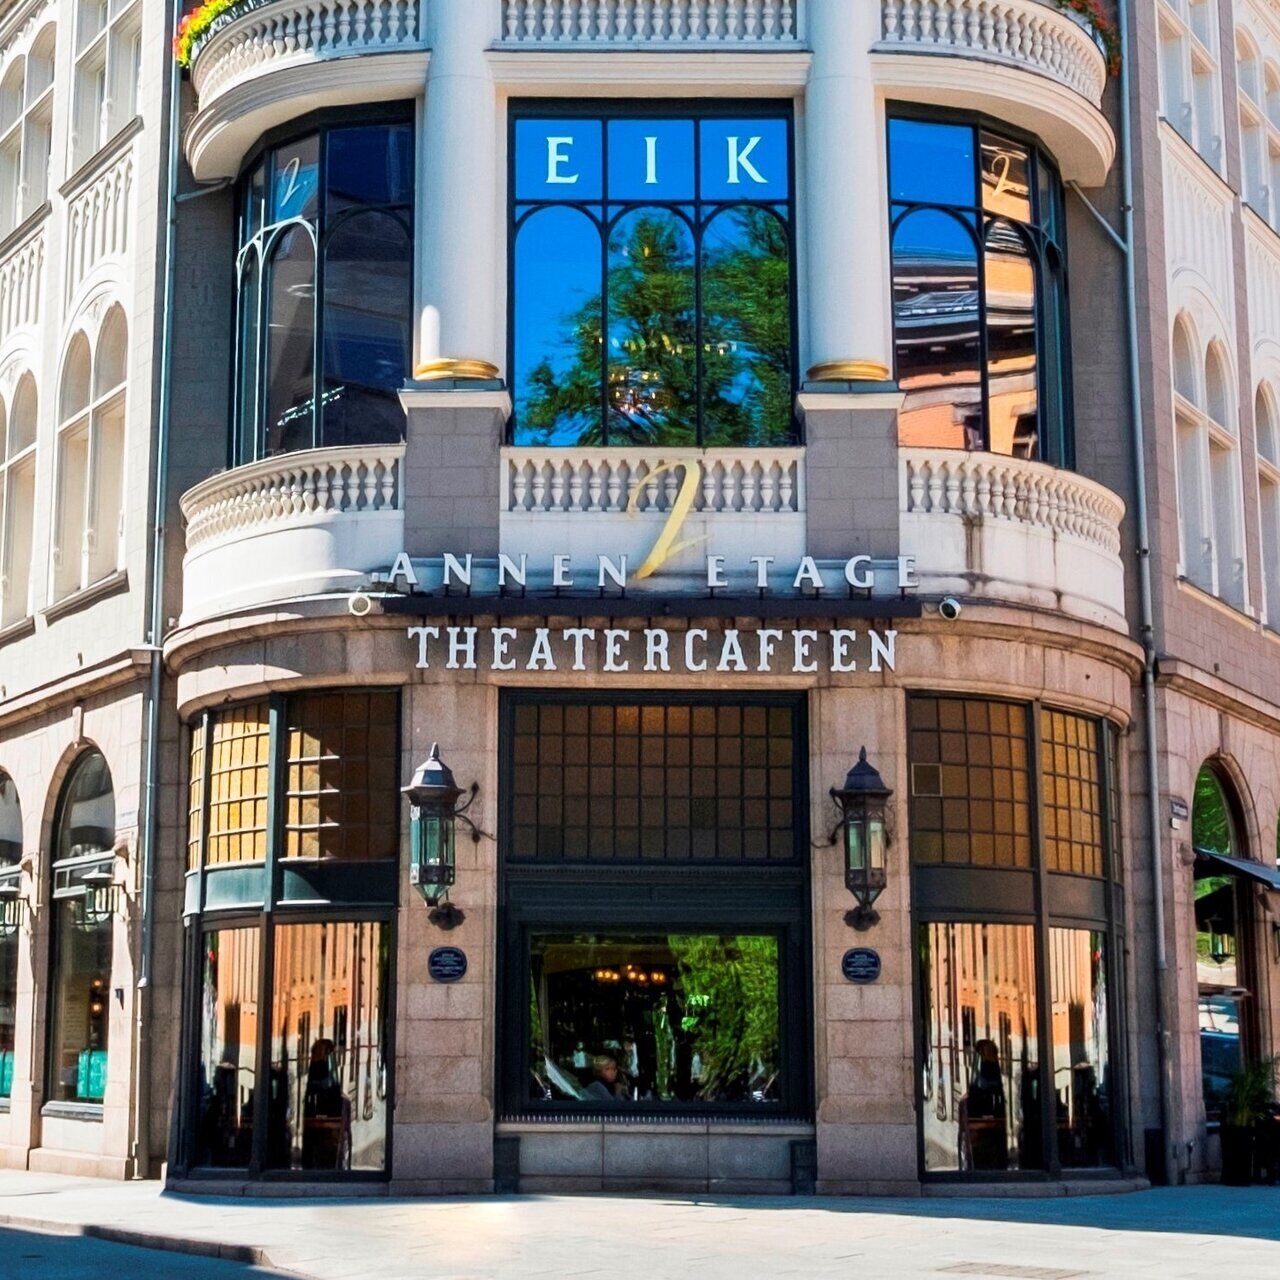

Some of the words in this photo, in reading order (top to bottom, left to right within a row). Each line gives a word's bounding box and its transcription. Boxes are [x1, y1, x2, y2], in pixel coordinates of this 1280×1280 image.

[546, 136, 768, 184] EIK
[388, 552, 628, 587] ANNEN
[627, 459, 712, 581] 2
[707, 554, 918, 589] ETAGE
[407, 626, 898, 673] THEATERCAFEEN
